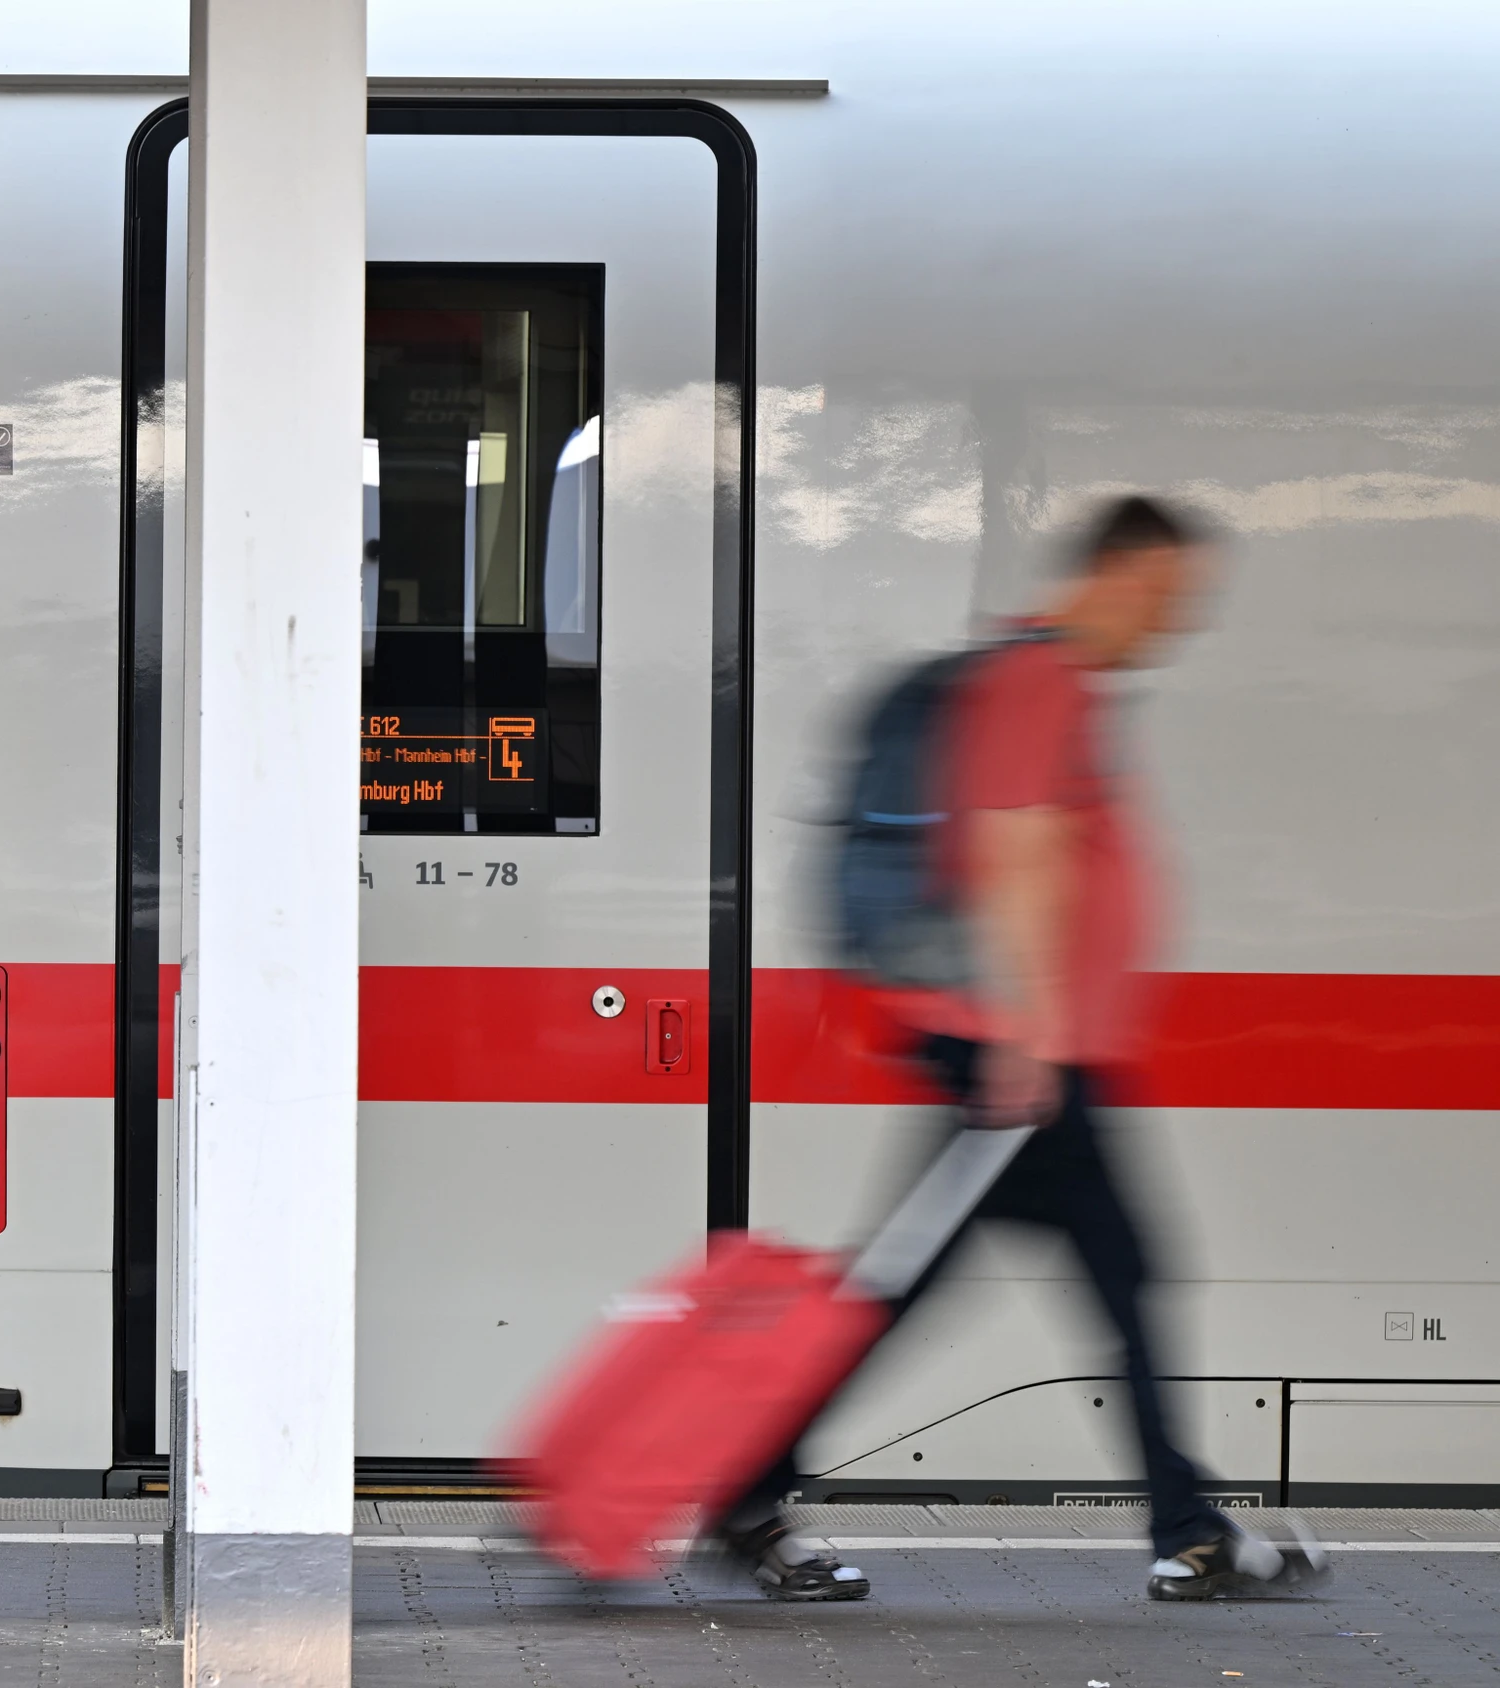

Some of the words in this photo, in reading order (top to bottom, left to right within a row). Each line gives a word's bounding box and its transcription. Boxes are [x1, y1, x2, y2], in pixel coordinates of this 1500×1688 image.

[369, 716, 400, 736] 612
[361, 747, 382, 763] Hbf
[394, 747, 452, 763] Mannheim
[454, 747, 477, 763] Hbf
[502, 738, 523, 779] 4
[359, 779, 410, 805] mburg
[414, 779, 444, 800] Hbf
[415, 861, 446, 885] 11
[484, 861, 519, 887] 78
[1423, 1318, 1447, 1341] HL
